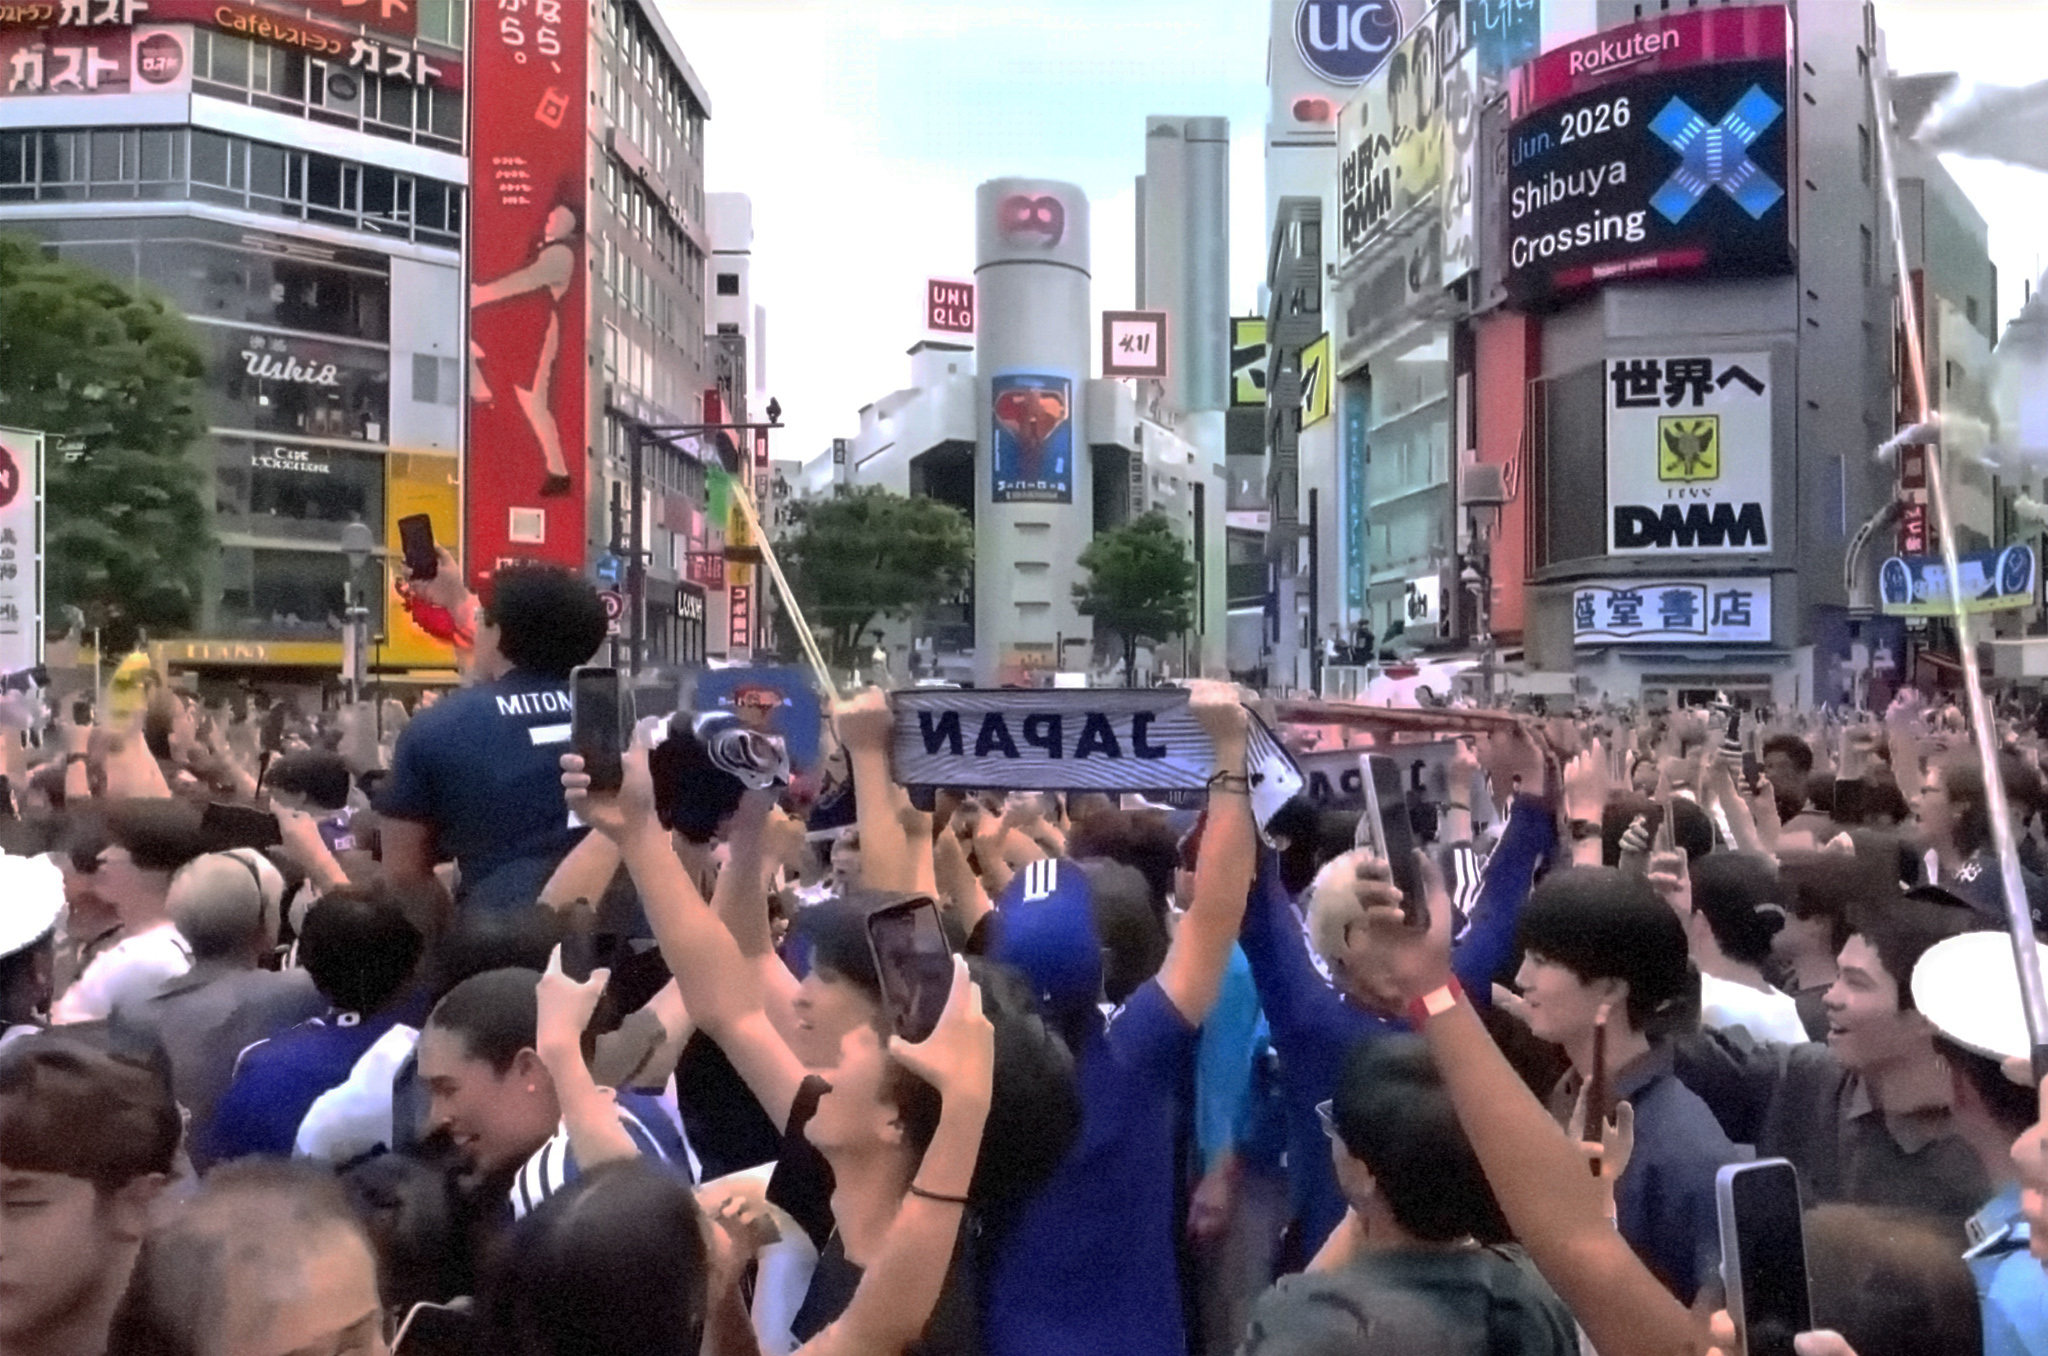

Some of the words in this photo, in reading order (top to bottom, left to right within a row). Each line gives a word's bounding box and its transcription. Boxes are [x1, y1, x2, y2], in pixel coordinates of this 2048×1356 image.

[9, 42, 119, 92] ガスト
[350, 38, 442, 85] ガスト
[1512, 132, 1555, 167] Jun.
[1560, 96, 1631, 145] 2026
[1511, 160, 1627, 219] Shibuya
[1511, 208, 1647, 269] Crossing
[934, 286, 968, 308] UNI
[1610, 357, 1766, 409] 世界へ
[1614, 502, 1768, 549] DMM
